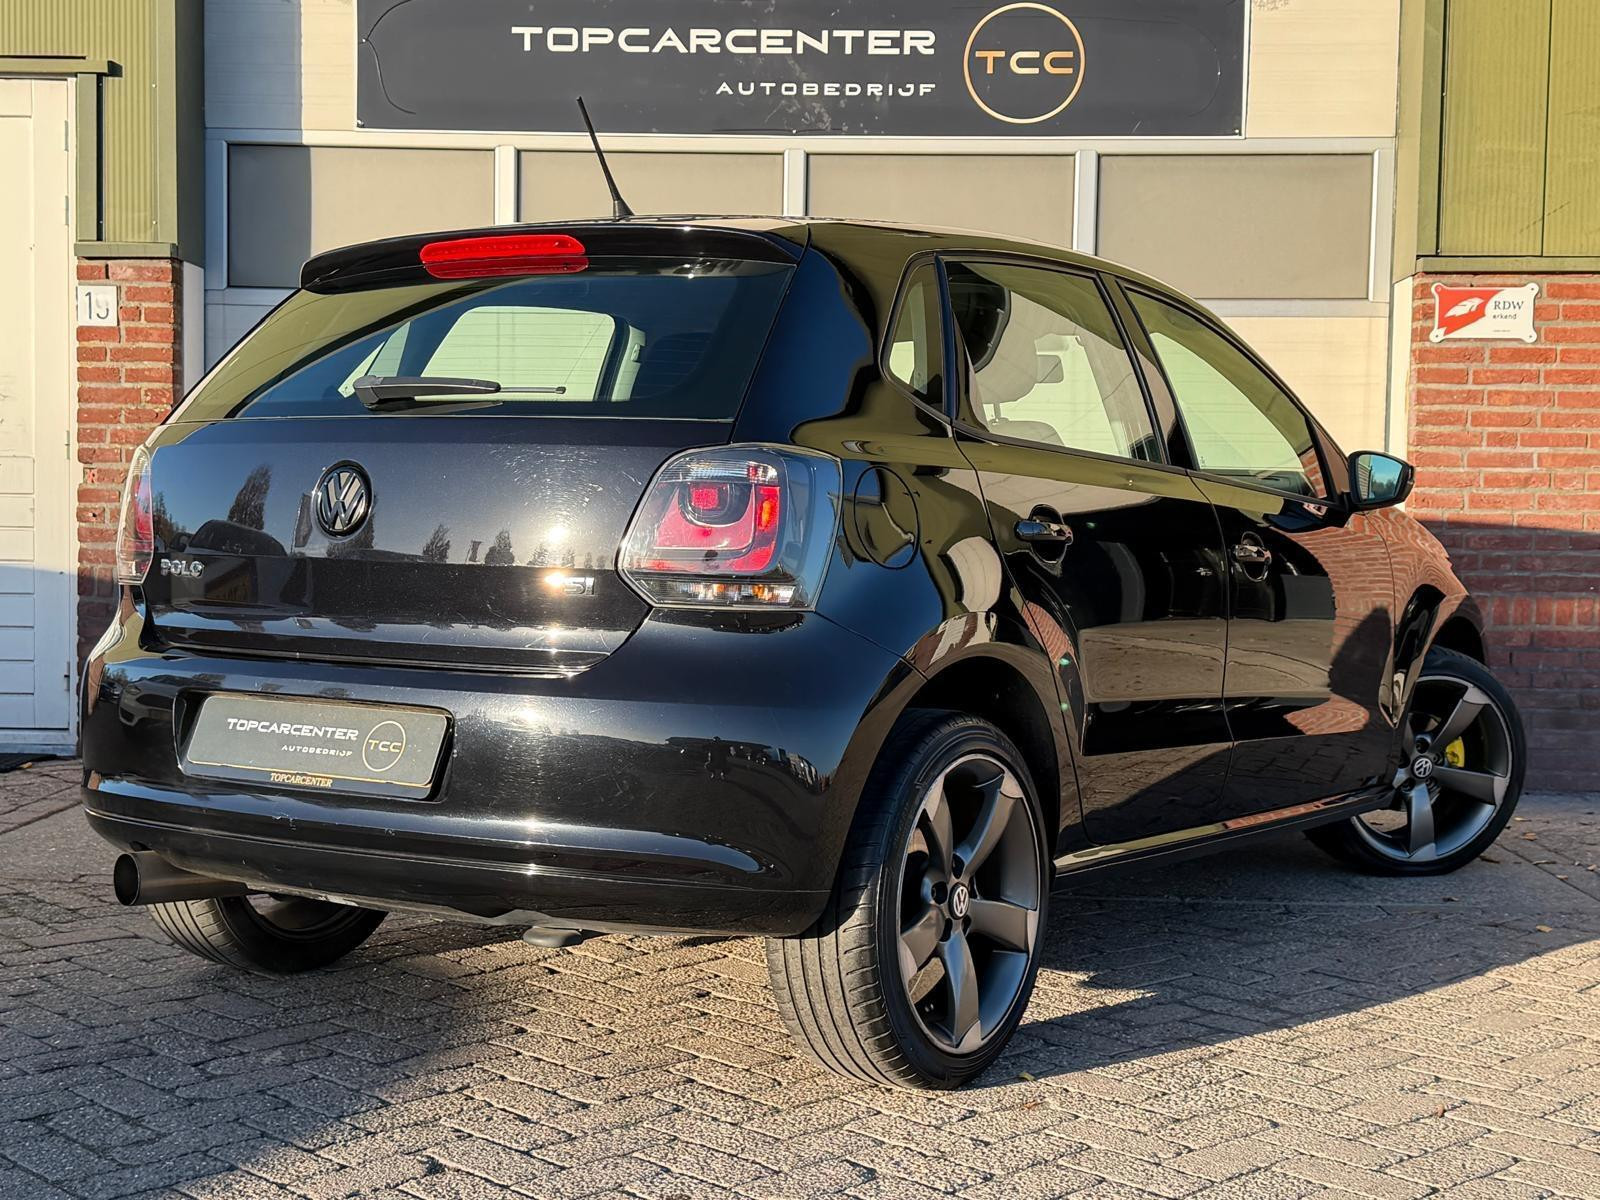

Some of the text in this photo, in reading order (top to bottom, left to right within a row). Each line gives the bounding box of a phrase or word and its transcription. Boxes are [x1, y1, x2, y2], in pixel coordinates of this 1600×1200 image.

[511, 26, 936, 56] TOPCARCENTER
[974, 49, 1075, 75] TCC
[715, 81, 937, 98] AUTOBEDRIJF
[1494, 301, 1524, 310] RDW
[160, 558, 204, 577] POLO
[544, 576, 595, 596] SI
[227, 718, 359, 741] TOPCARCENTER
[281, 744, 353, 757] AUTOBEDRIJF
[368, 739, 402, 753] TCC
[270, 772, 333, 788] TOPCARCENTER
